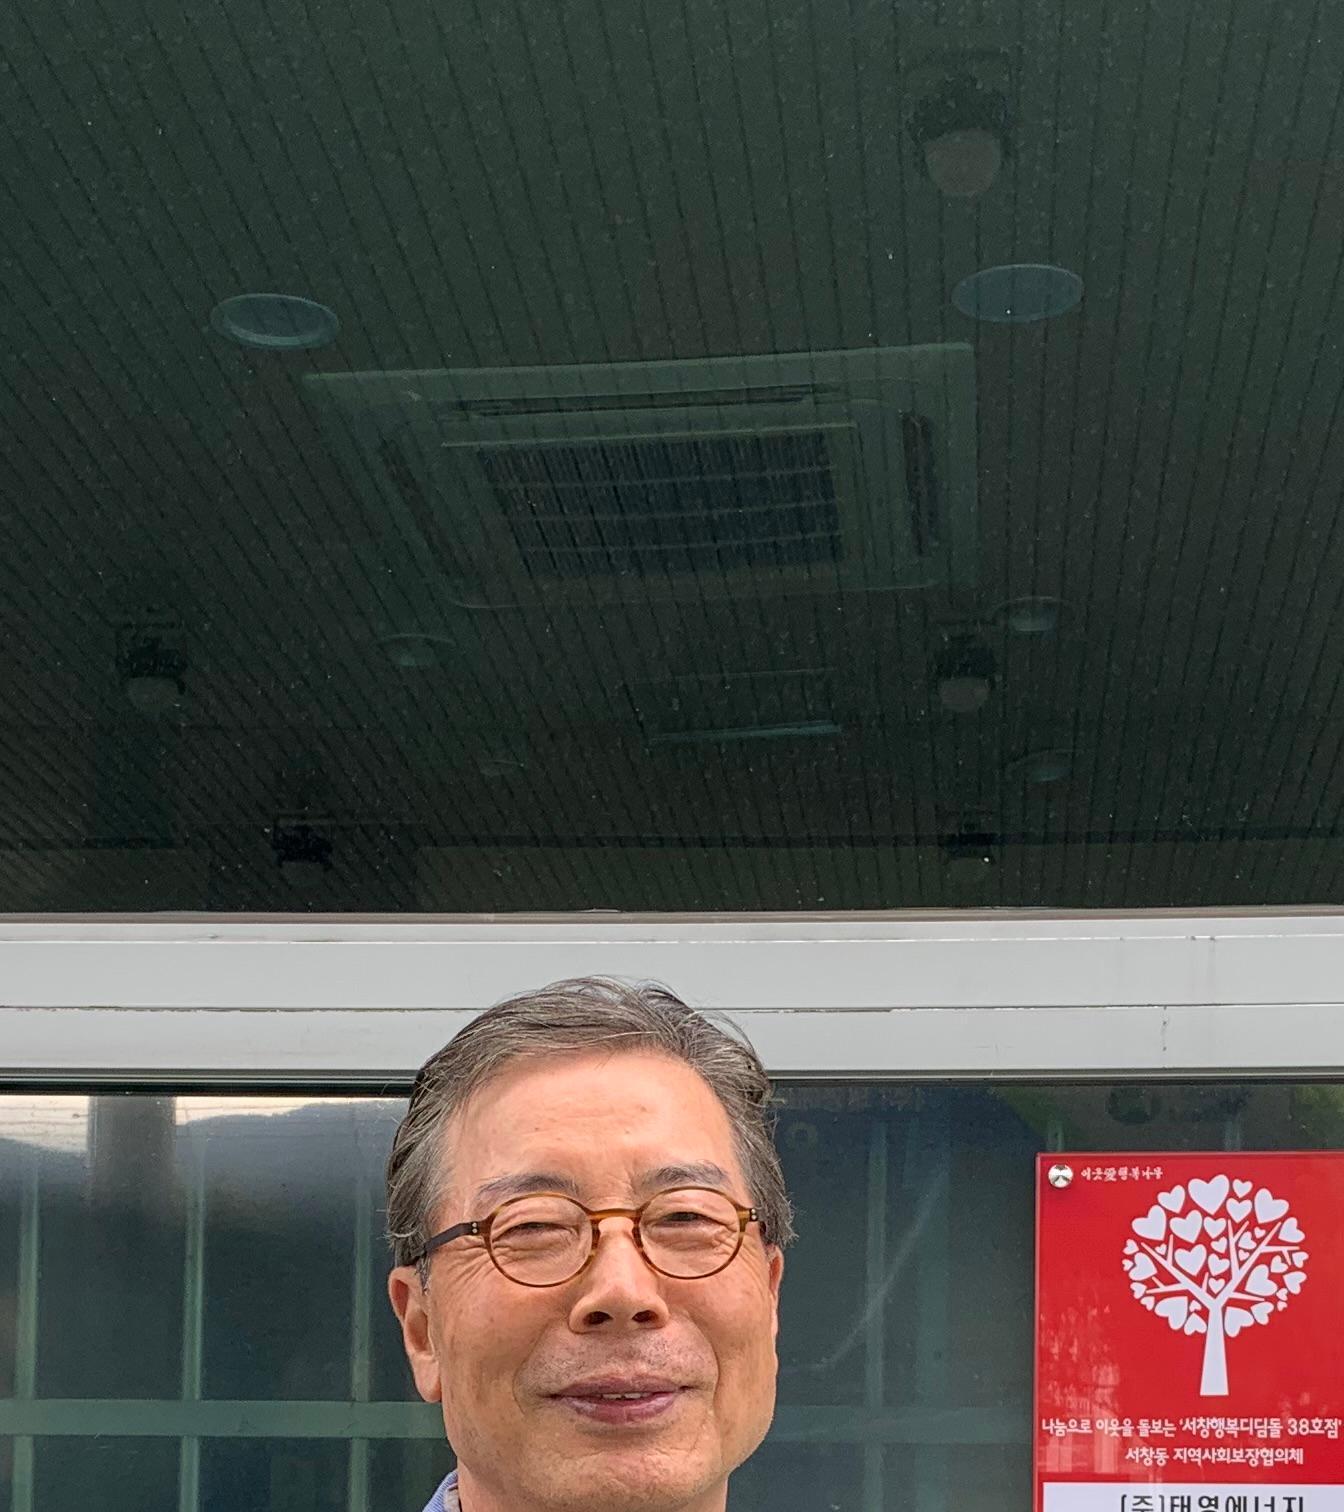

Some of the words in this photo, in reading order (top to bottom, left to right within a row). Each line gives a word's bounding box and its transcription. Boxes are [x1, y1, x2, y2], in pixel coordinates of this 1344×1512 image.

[1041, 1418, 1093, 1438] 나눔으로
[1096, 1418, 1135, 1438] 이웃을
[1137, 1418, 1176, 1438] 돌보는
[1125, 1448, 1168, 1466] 서창동
[1173, 1447, 1305, 1467] 지역사회보장협의체
